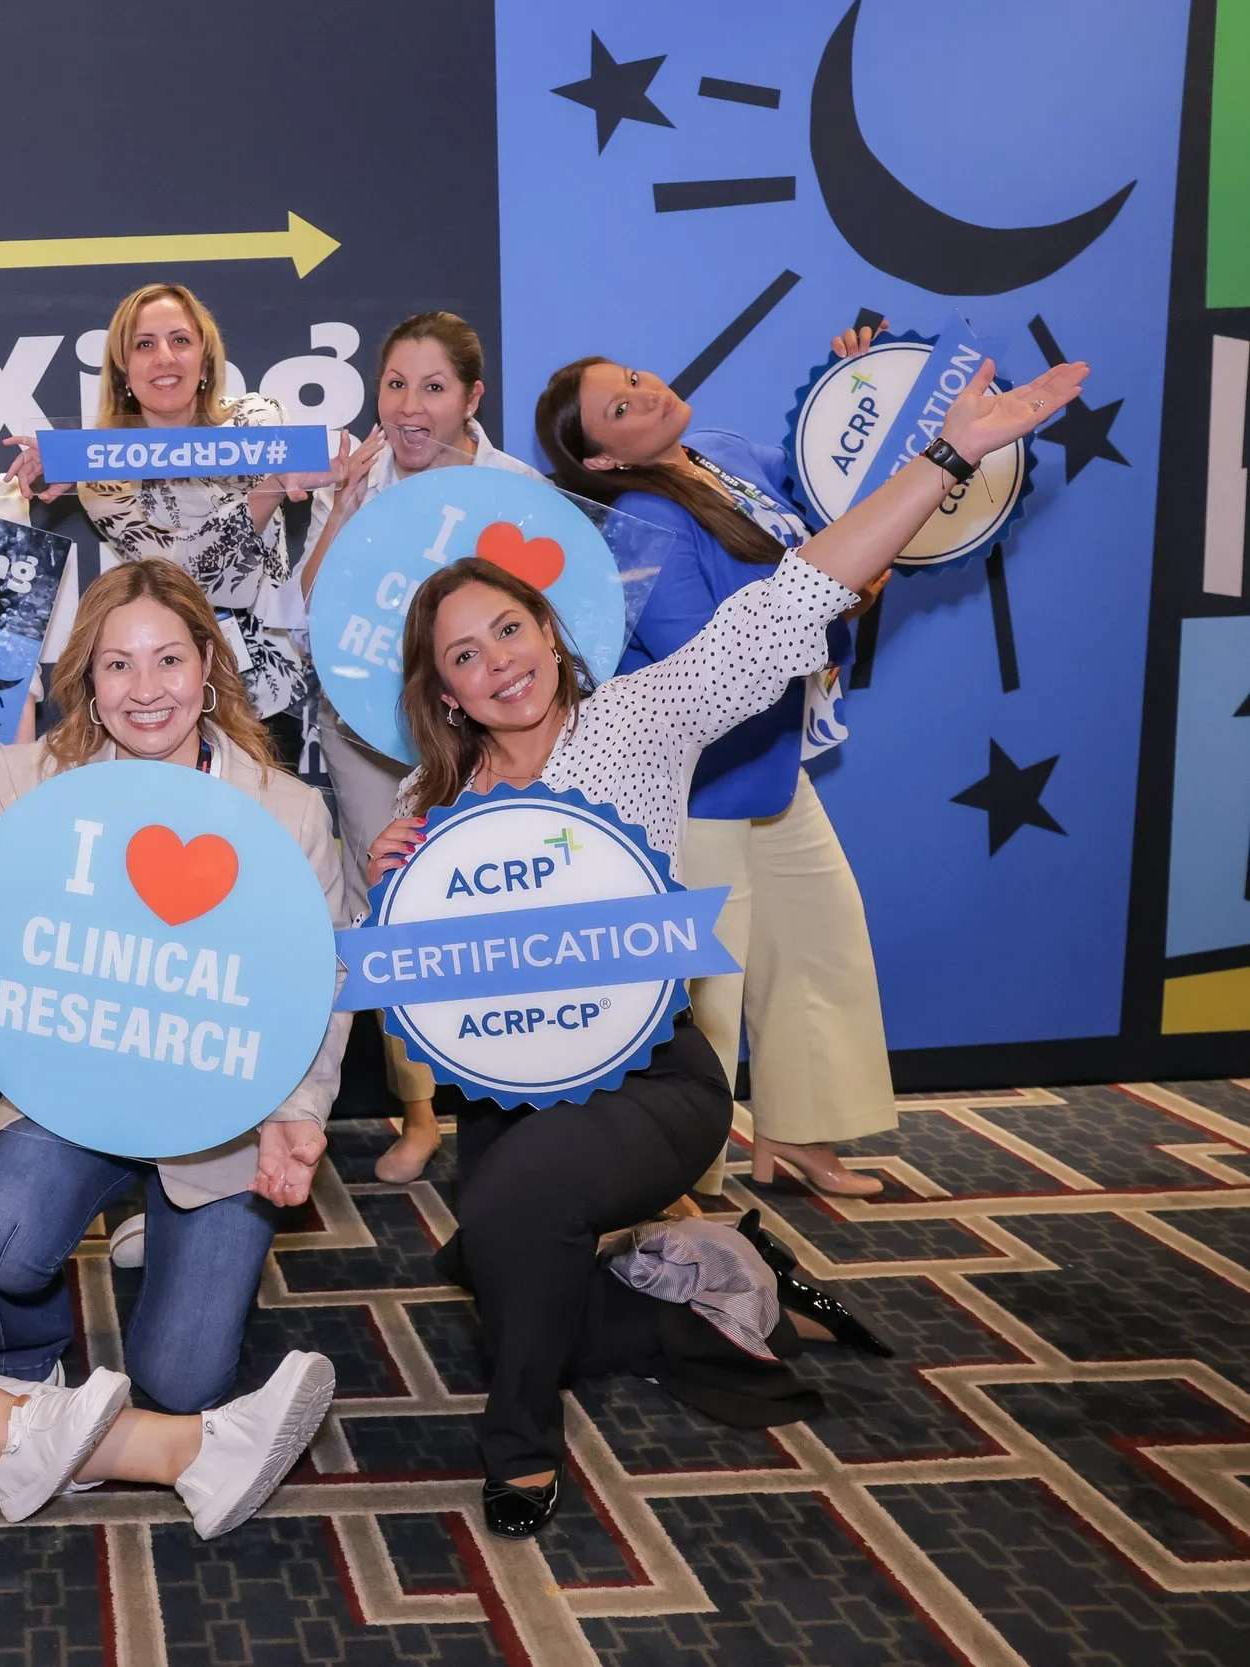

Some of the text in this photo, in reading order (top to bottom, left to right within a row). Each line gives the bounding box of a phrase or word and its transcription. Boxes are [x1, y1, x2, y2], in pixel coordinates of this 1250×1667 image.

[86, 439, 288, 469] #ACRP2025
[831, 396, 881, 476] ACRP
[699, 458, 740, 487] ACRP 2025
[423, 504, 467, 565] I
[65, 819, 104, 896] I
[445, 856, 555, 900] ACRP
[22, 915, 250, 1007] CLINICAL
[362, 917, 698, 985] CERTIFICATION
